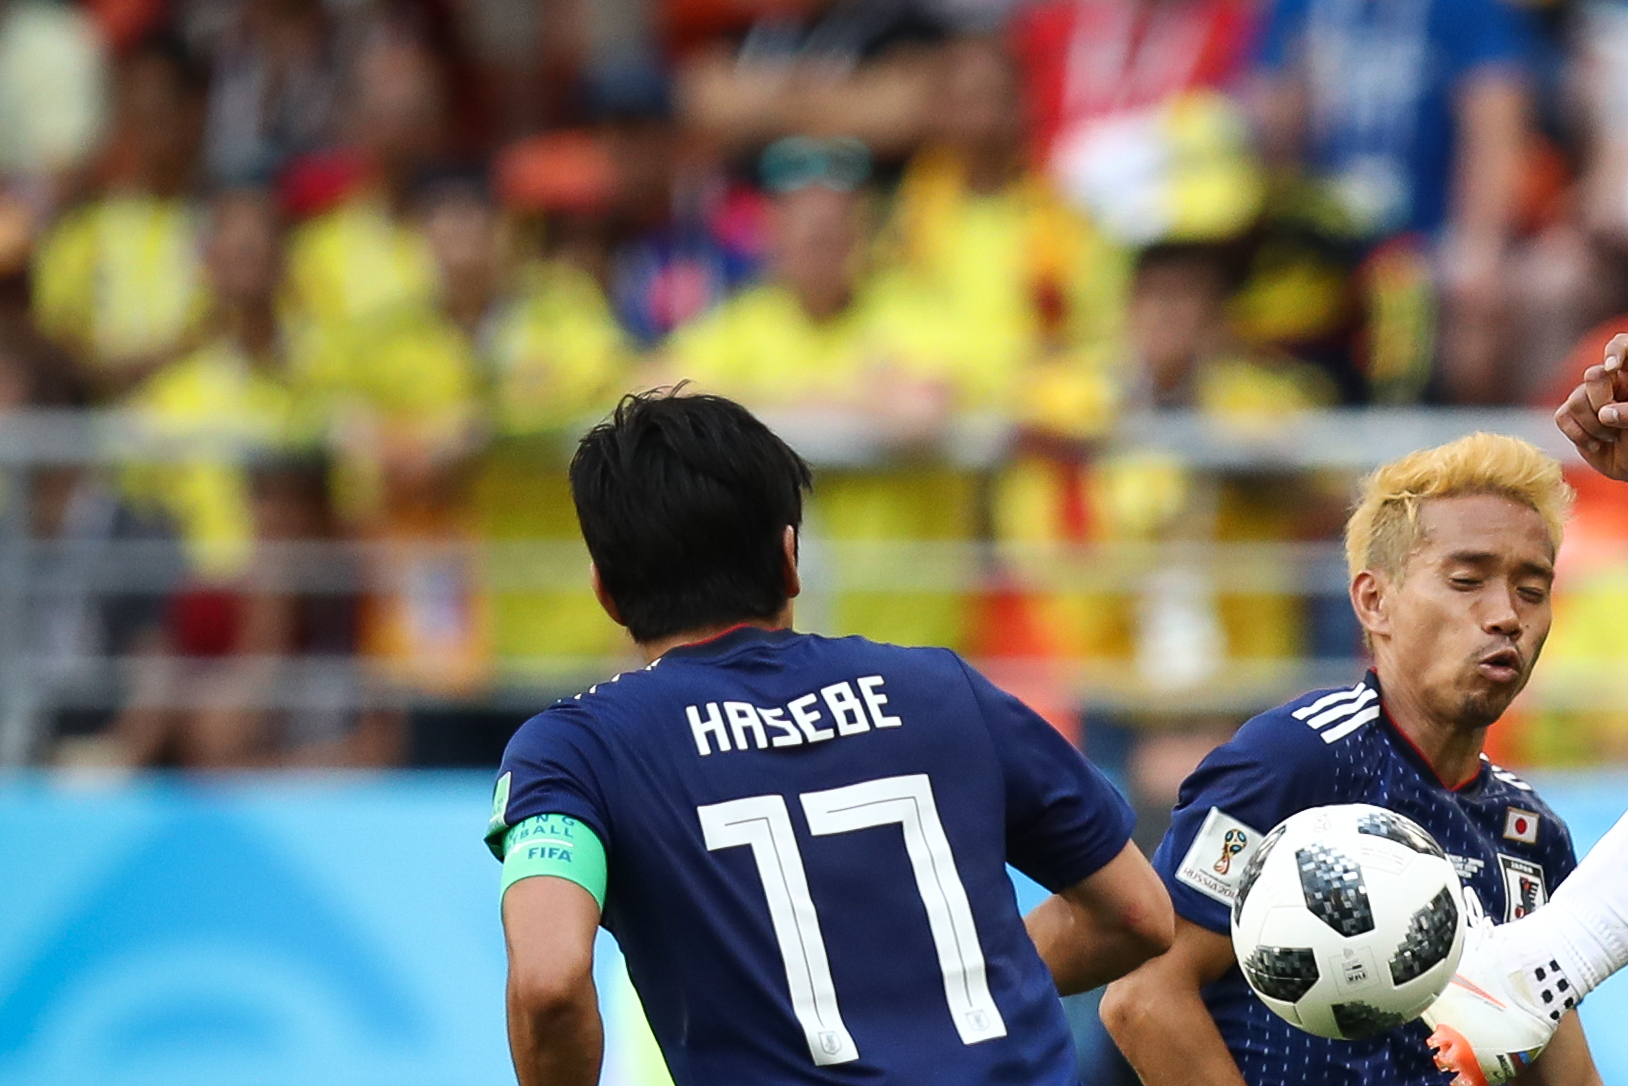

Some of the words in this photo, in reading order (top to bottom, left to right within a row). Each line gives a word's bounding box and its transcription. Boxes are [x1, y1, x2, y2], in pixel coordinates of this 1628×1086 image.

[686, 675, 902, 756] HASEBE
[527, 847, 574, 863] FIFA
[1182, 867, 1218, 891] RUSSIA
